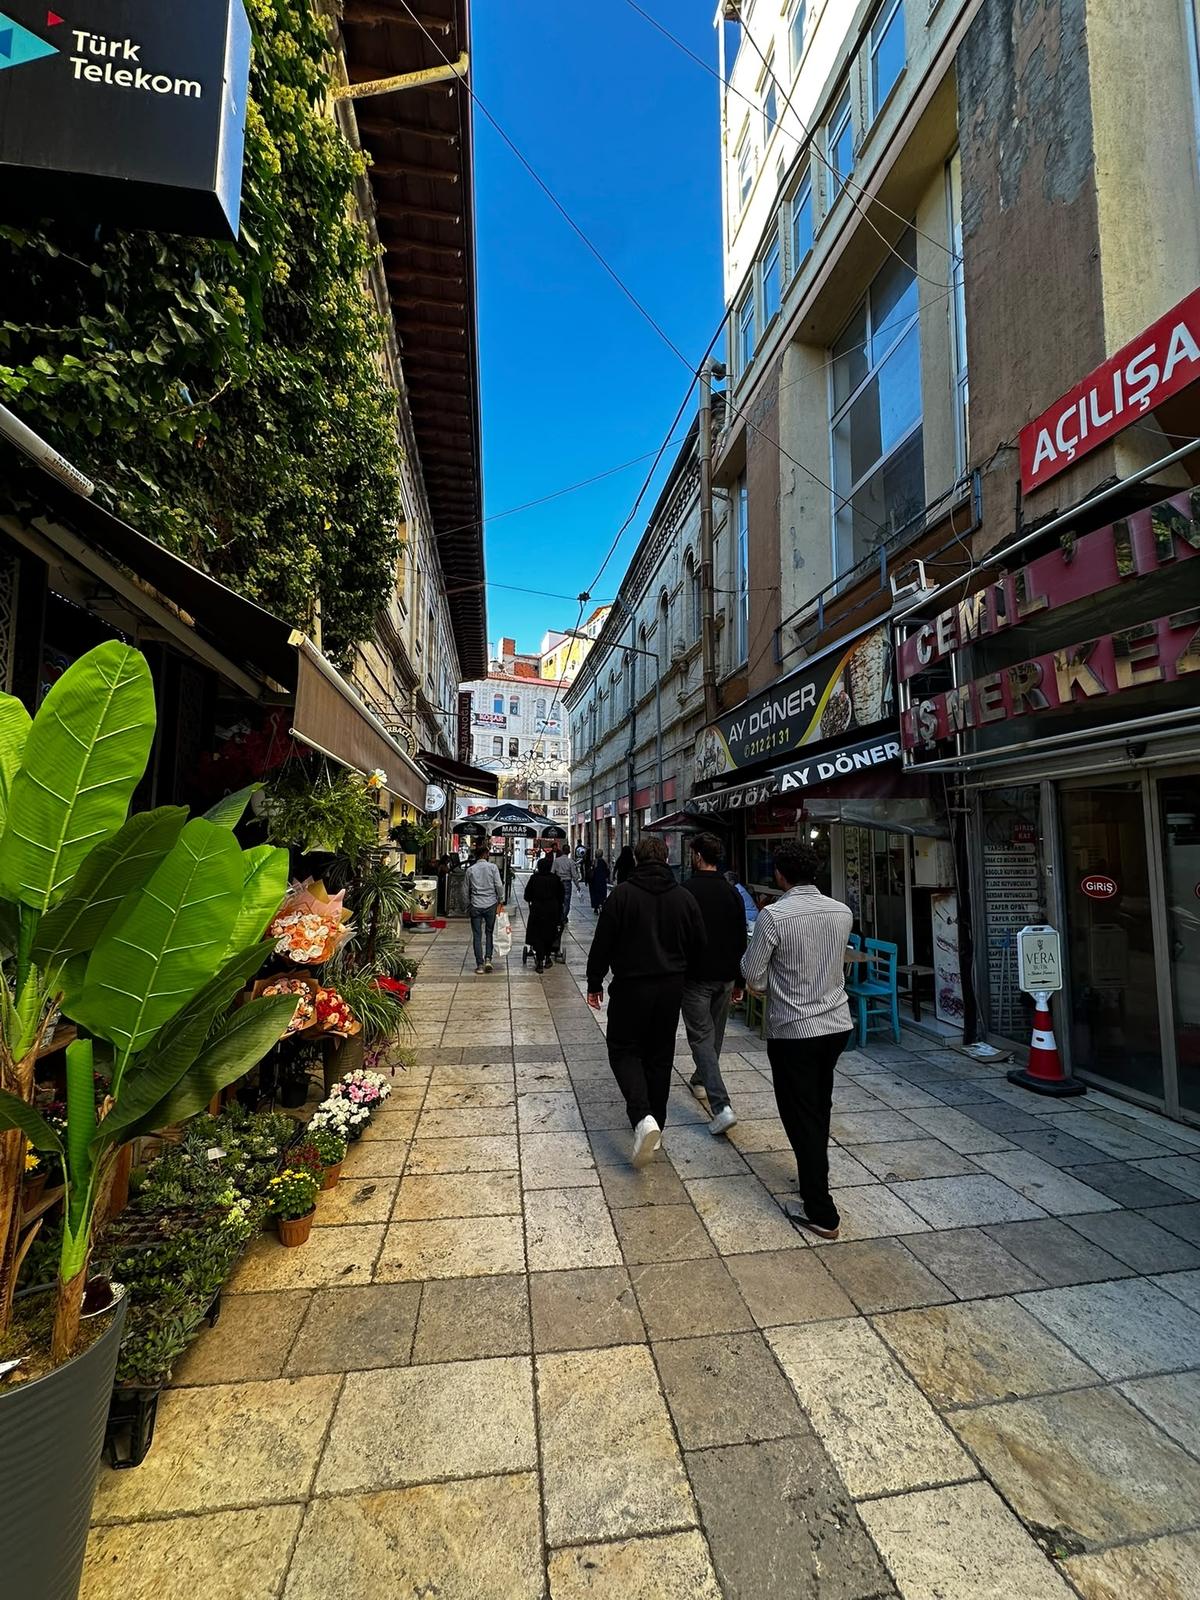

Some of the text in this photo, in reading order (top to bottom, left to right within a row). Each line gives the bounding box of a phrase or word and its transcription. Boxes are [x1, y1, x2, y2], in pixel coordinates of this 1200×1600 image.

[72, 29, 141, 62] Türk
[69, 56, 202, 98] Telekom
[728, 682, 817, 745] AY DÖNER
[781, 741, 900, 791] AY DÖNER
[1026, 952, 1056, 965] VERA
